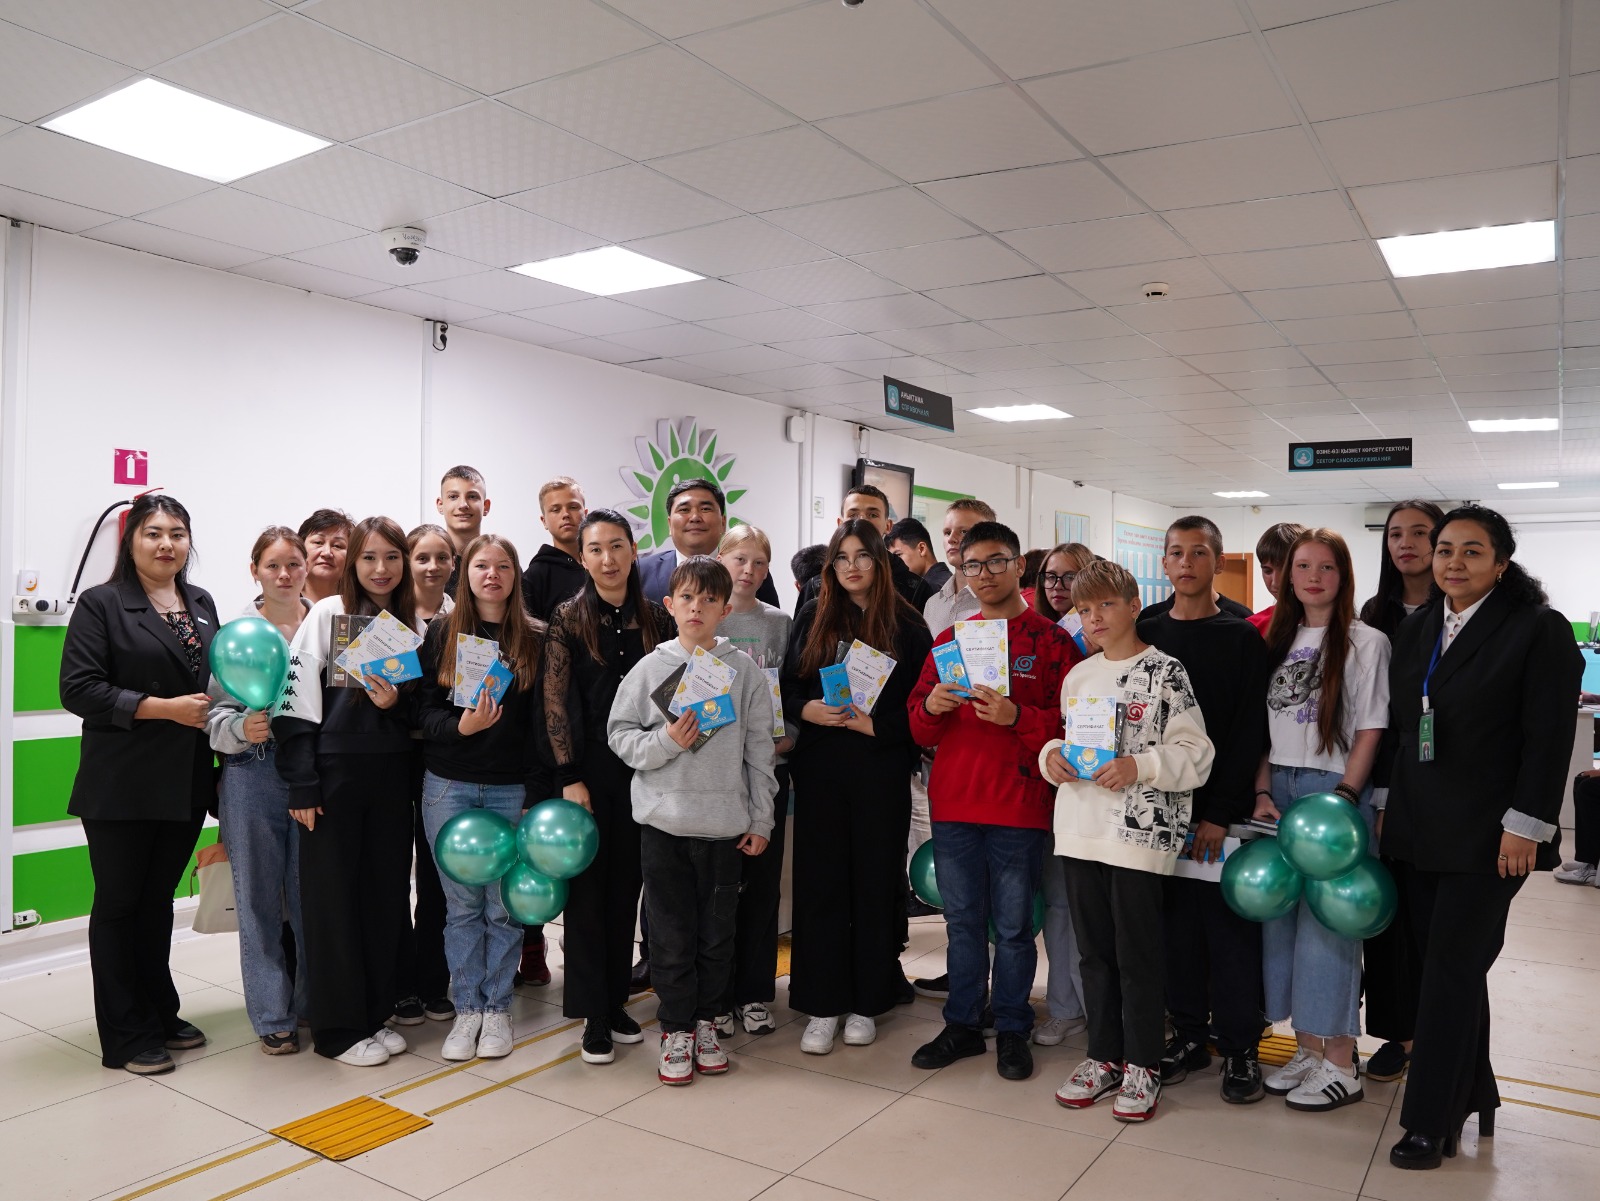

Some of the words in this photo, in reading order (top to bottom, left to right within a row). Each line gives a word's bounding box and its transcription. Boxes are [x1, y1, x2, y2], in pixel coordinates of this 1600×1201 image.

[901, 403, 930, 417] СПРАВОЧНАЯ
[373, 634, 397, 653] СЕРТИФИКАТ
[851, 665, 875, 681] СЕРТИФИКАТ
[694, 674, 719, 691] СЕРТИФИКАТ
